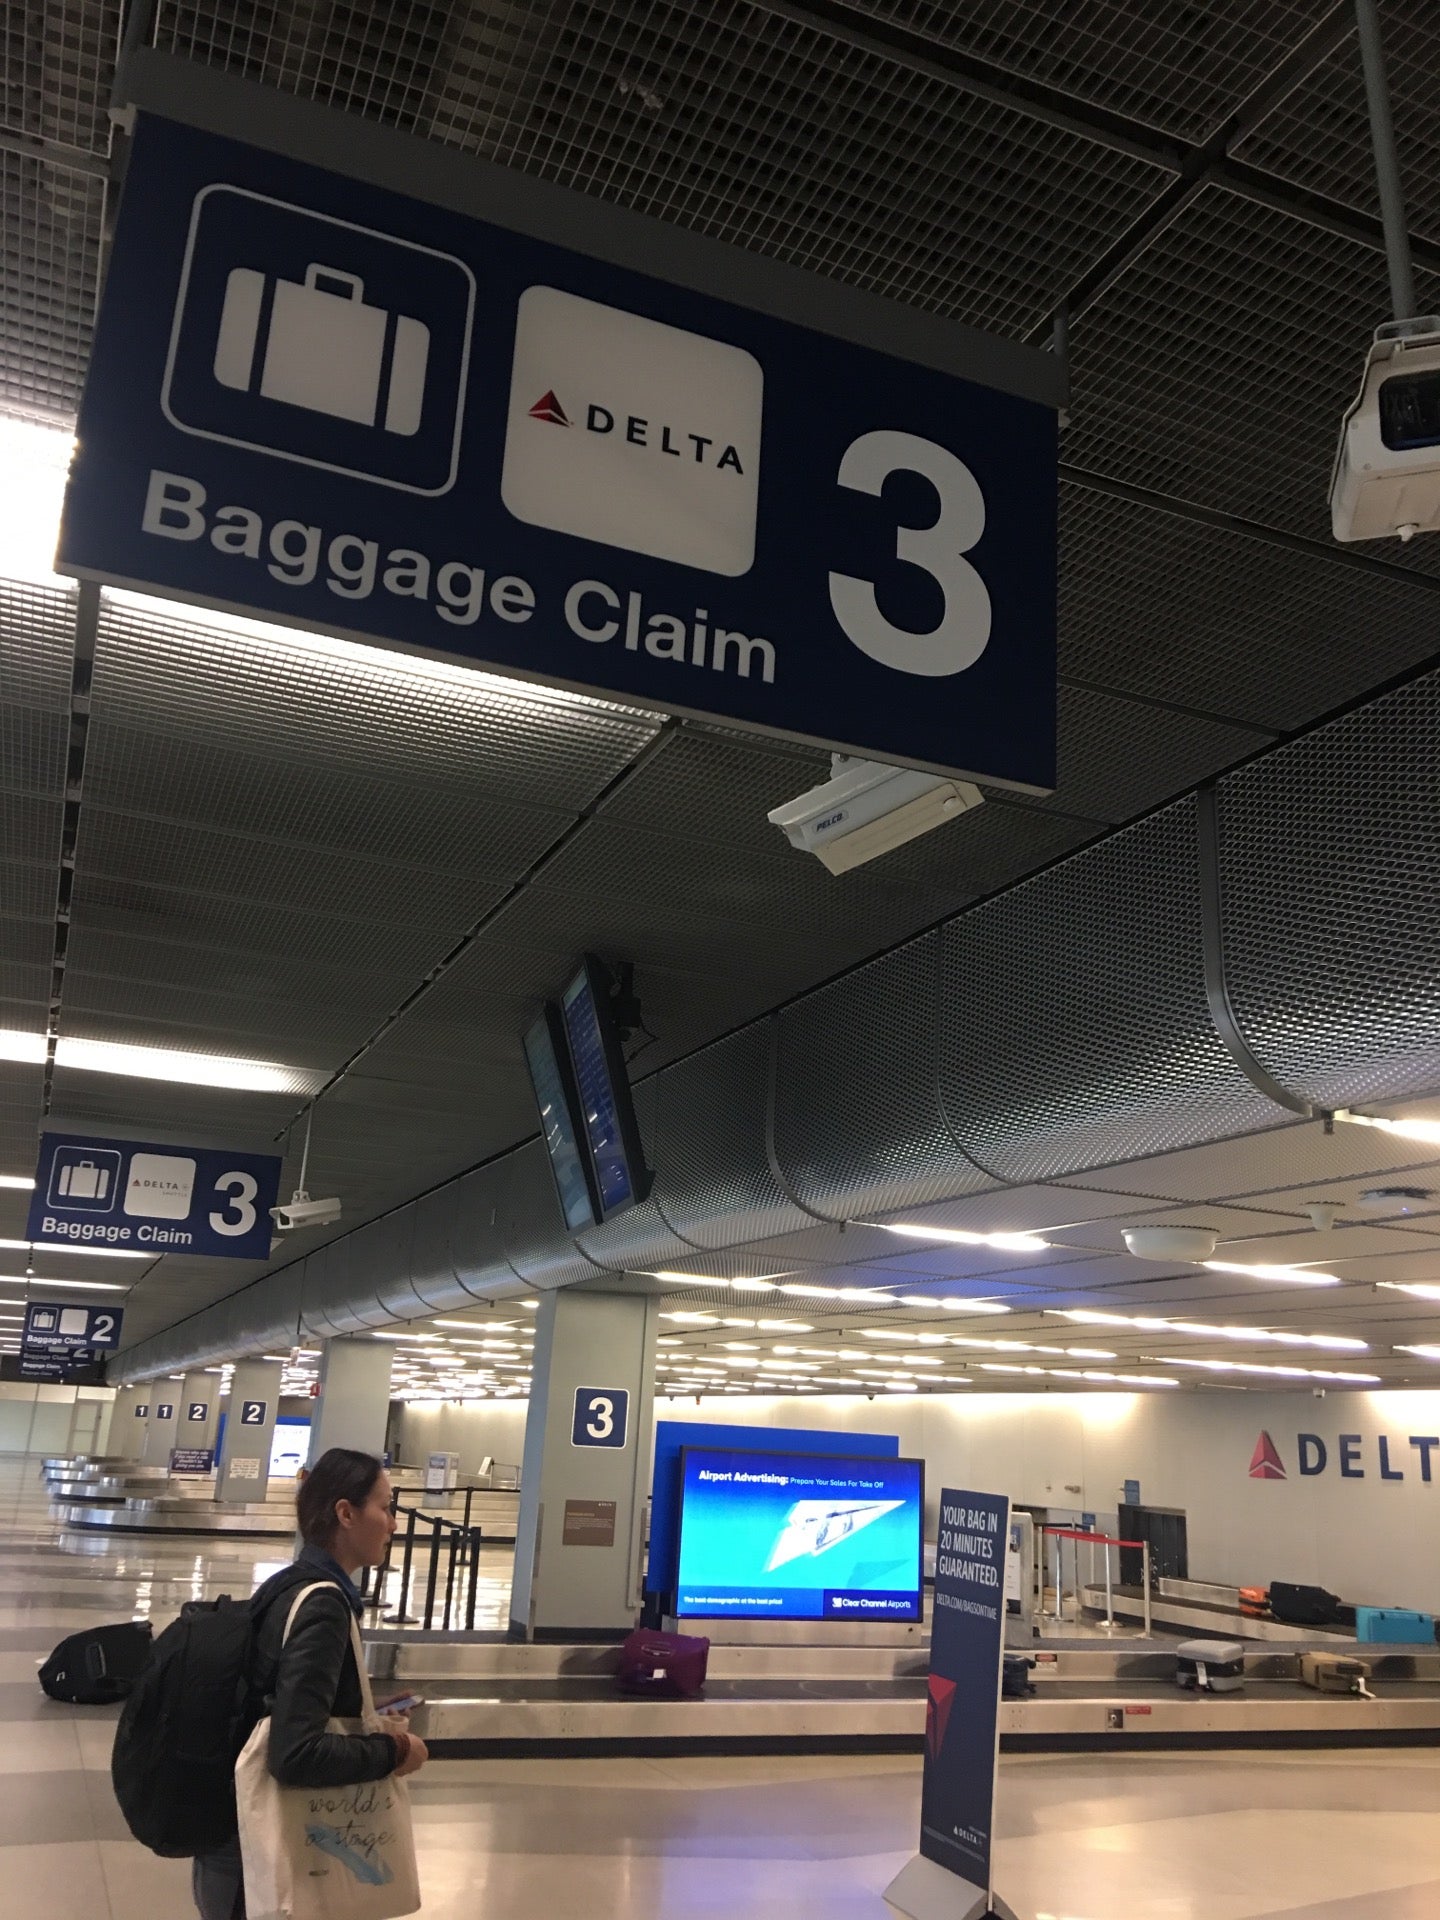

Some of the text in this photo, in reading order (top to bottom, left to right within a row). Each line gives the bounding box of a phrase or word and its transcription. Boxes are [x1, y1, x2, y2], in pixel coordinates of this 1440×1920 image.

[585, 402, 746, 476] DELTA
[828, 430, 992, 677] 3
[140, 470, 778, 685] Baggage Claim
[816, 812, 843, 832] PELCO
[143, 1179, 179, 1190] DELTA
[209, 1171, 258, 1236] 3
[42, 1217, 193, 1245] Baggage Claim
[27, 1335, 87, 1345] Baggage Claim
[91, 1315, 114, 1342] 2
[138, 1407, 145, 1415] 1
[162, 1407, 168, 1417] 1
[192, 1406, 203, 1419] 2
[246, 1404, 260, 1421] 2
[587, 1397, 613, 1438] 3
[699, 1471, 732, 1482] Airport
[734, 1472, 789, 1486] Advertising:
[790, 1477, 814, 1486] Prepare
[816, 1478, 829, 1486] Your
[830, 1479, 847, 1487] Sales
[859, 1480, 872, 1488] Take
[874, 1481, 884, 1489] Off
[943, 1505, 998, 1533] YOUR BAG IN
[940, 1530, 993, 1559] 20 MINUTES
[939, 1555, 999, 1588] GUARANTEED.
[843, 1599, 911, 1609] Clear Channel Airports
[958, 1828, 977, 1844] DELTA
